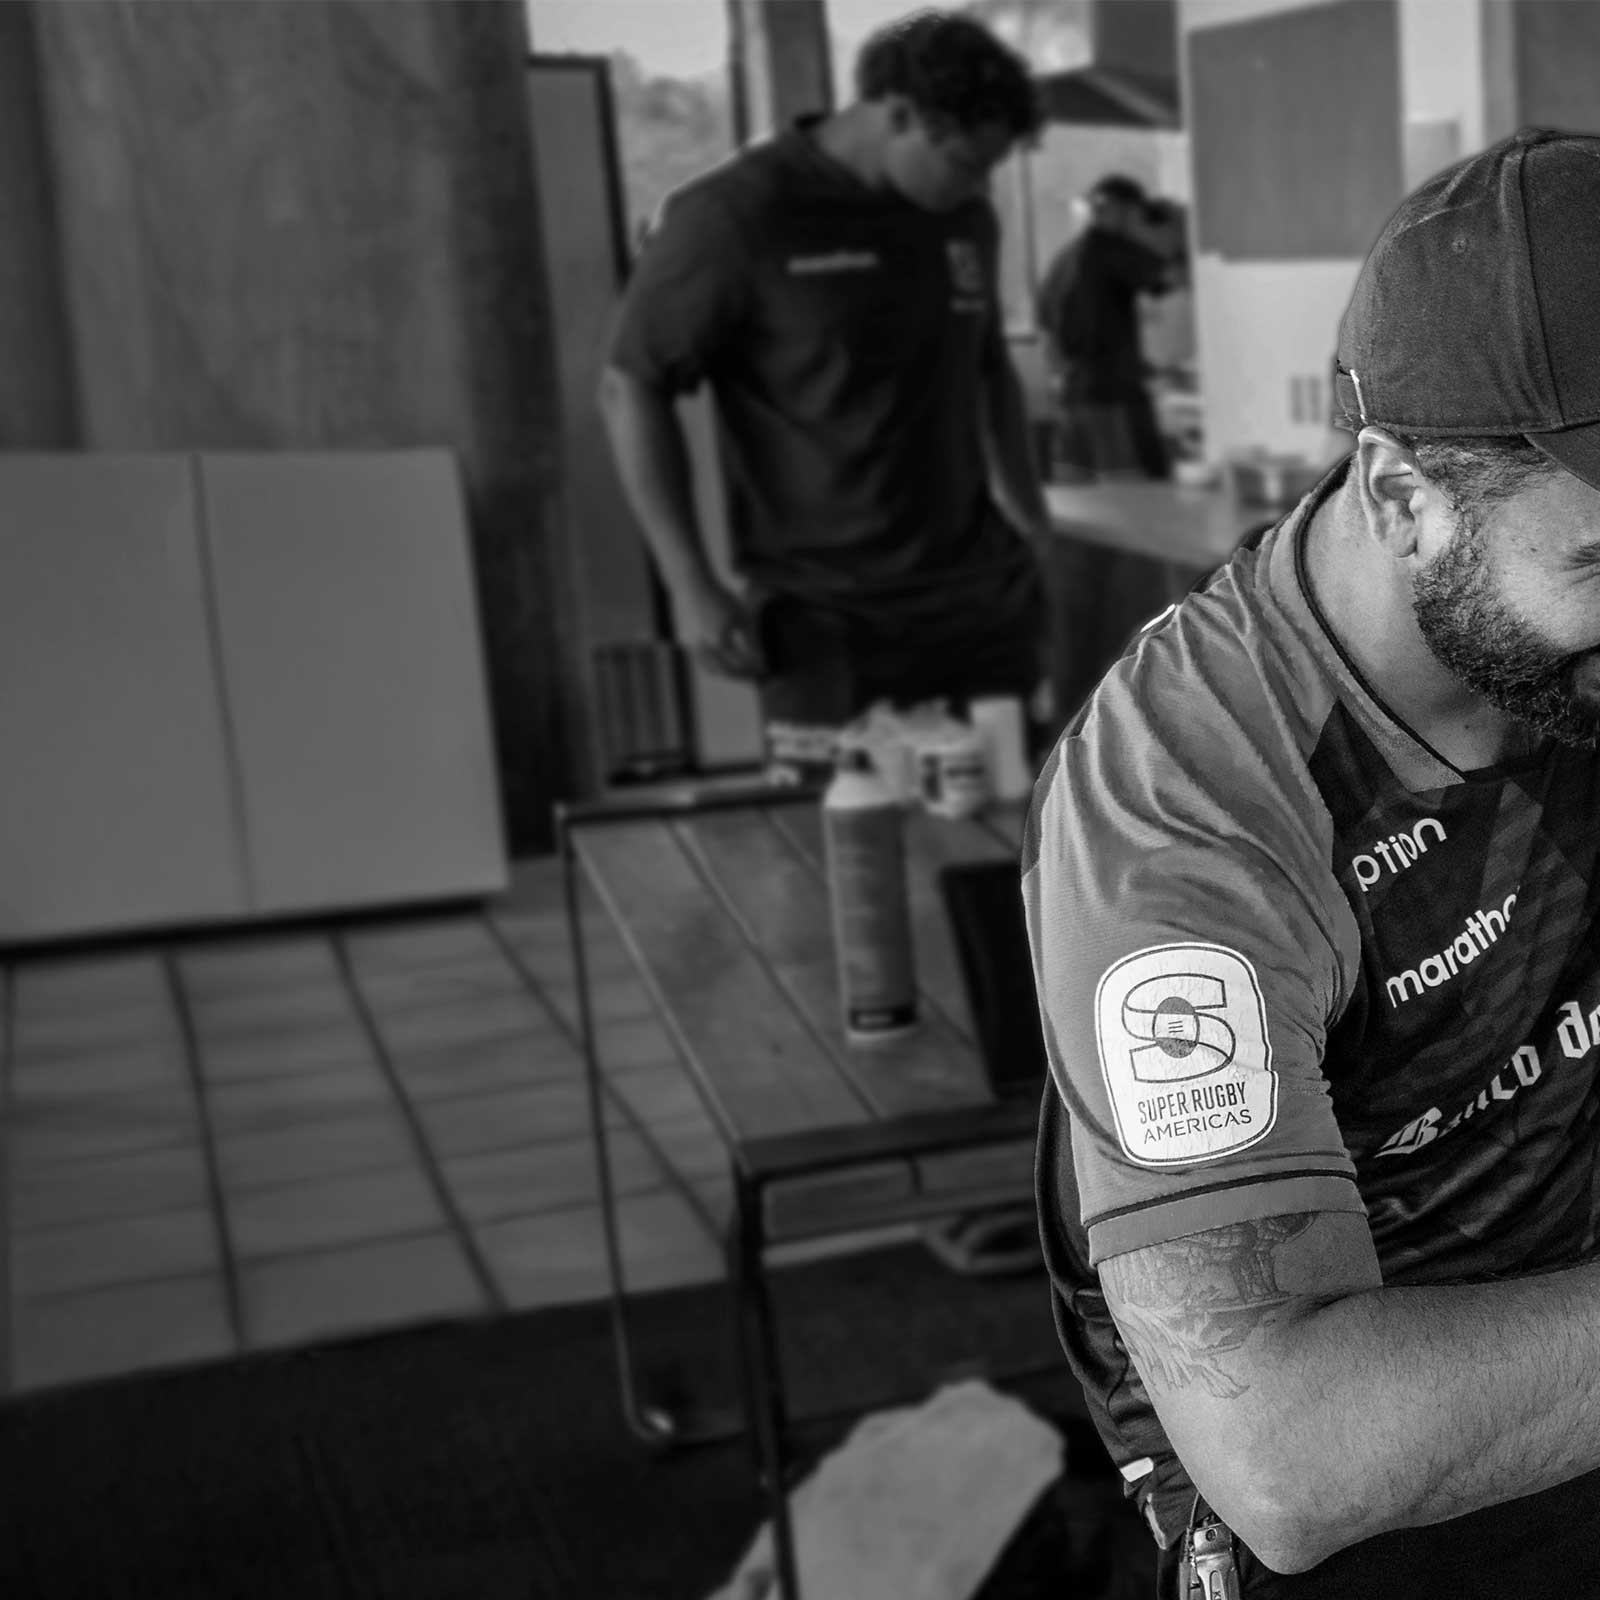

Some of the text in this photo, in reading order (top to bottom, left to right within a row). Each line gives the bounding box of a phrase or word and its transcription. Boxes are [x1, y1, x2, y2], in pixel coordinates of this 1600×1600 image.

[1385, 885, 1520, 1009] maratho
[1137, 1081, 1247, 1125] SUPER RUGBY
[1143, 1109, 1253, 1145] AMERICAS
